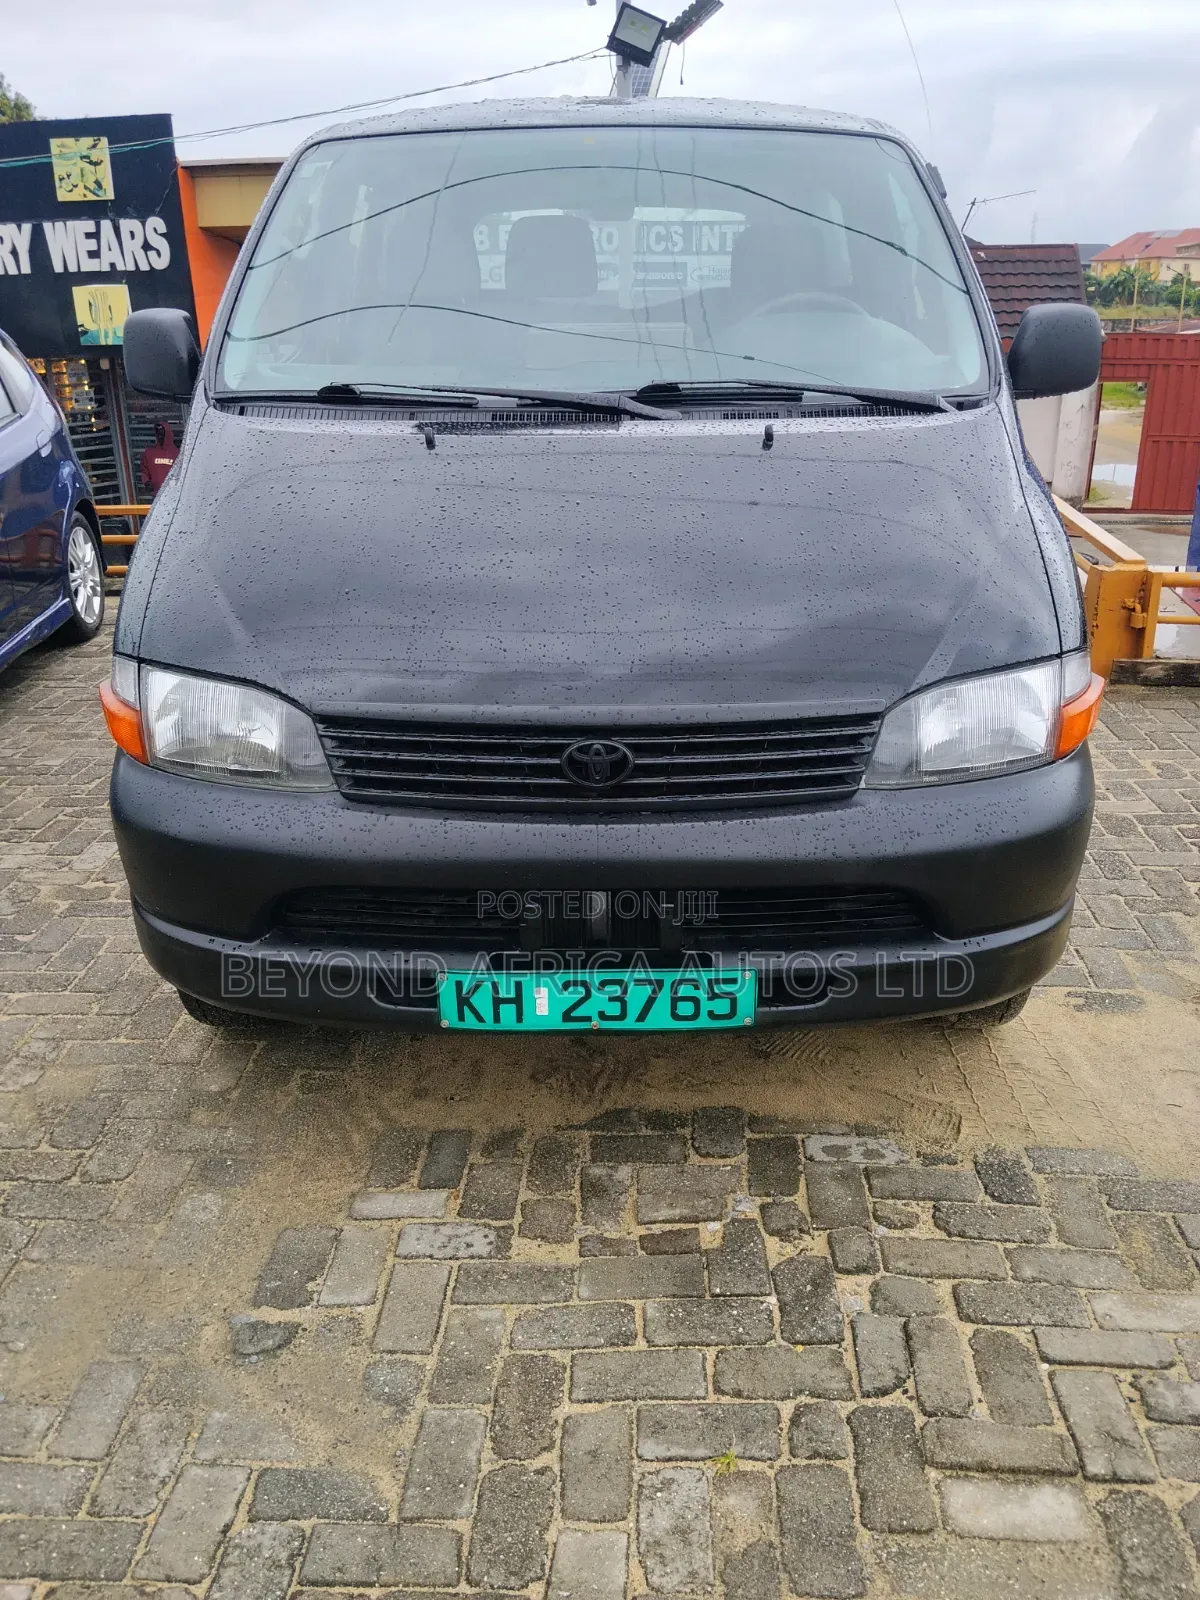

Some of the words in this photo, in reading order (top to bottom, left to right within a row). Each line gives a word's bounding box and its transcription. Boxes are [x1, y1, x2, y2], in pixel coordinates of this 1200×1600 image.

[42, 216, 171, 273] WEARS
[635, 270, 684, 281] anasonic
[455, 979, 524, 1025] KH
[560, 977, 739, 1024] 23765
